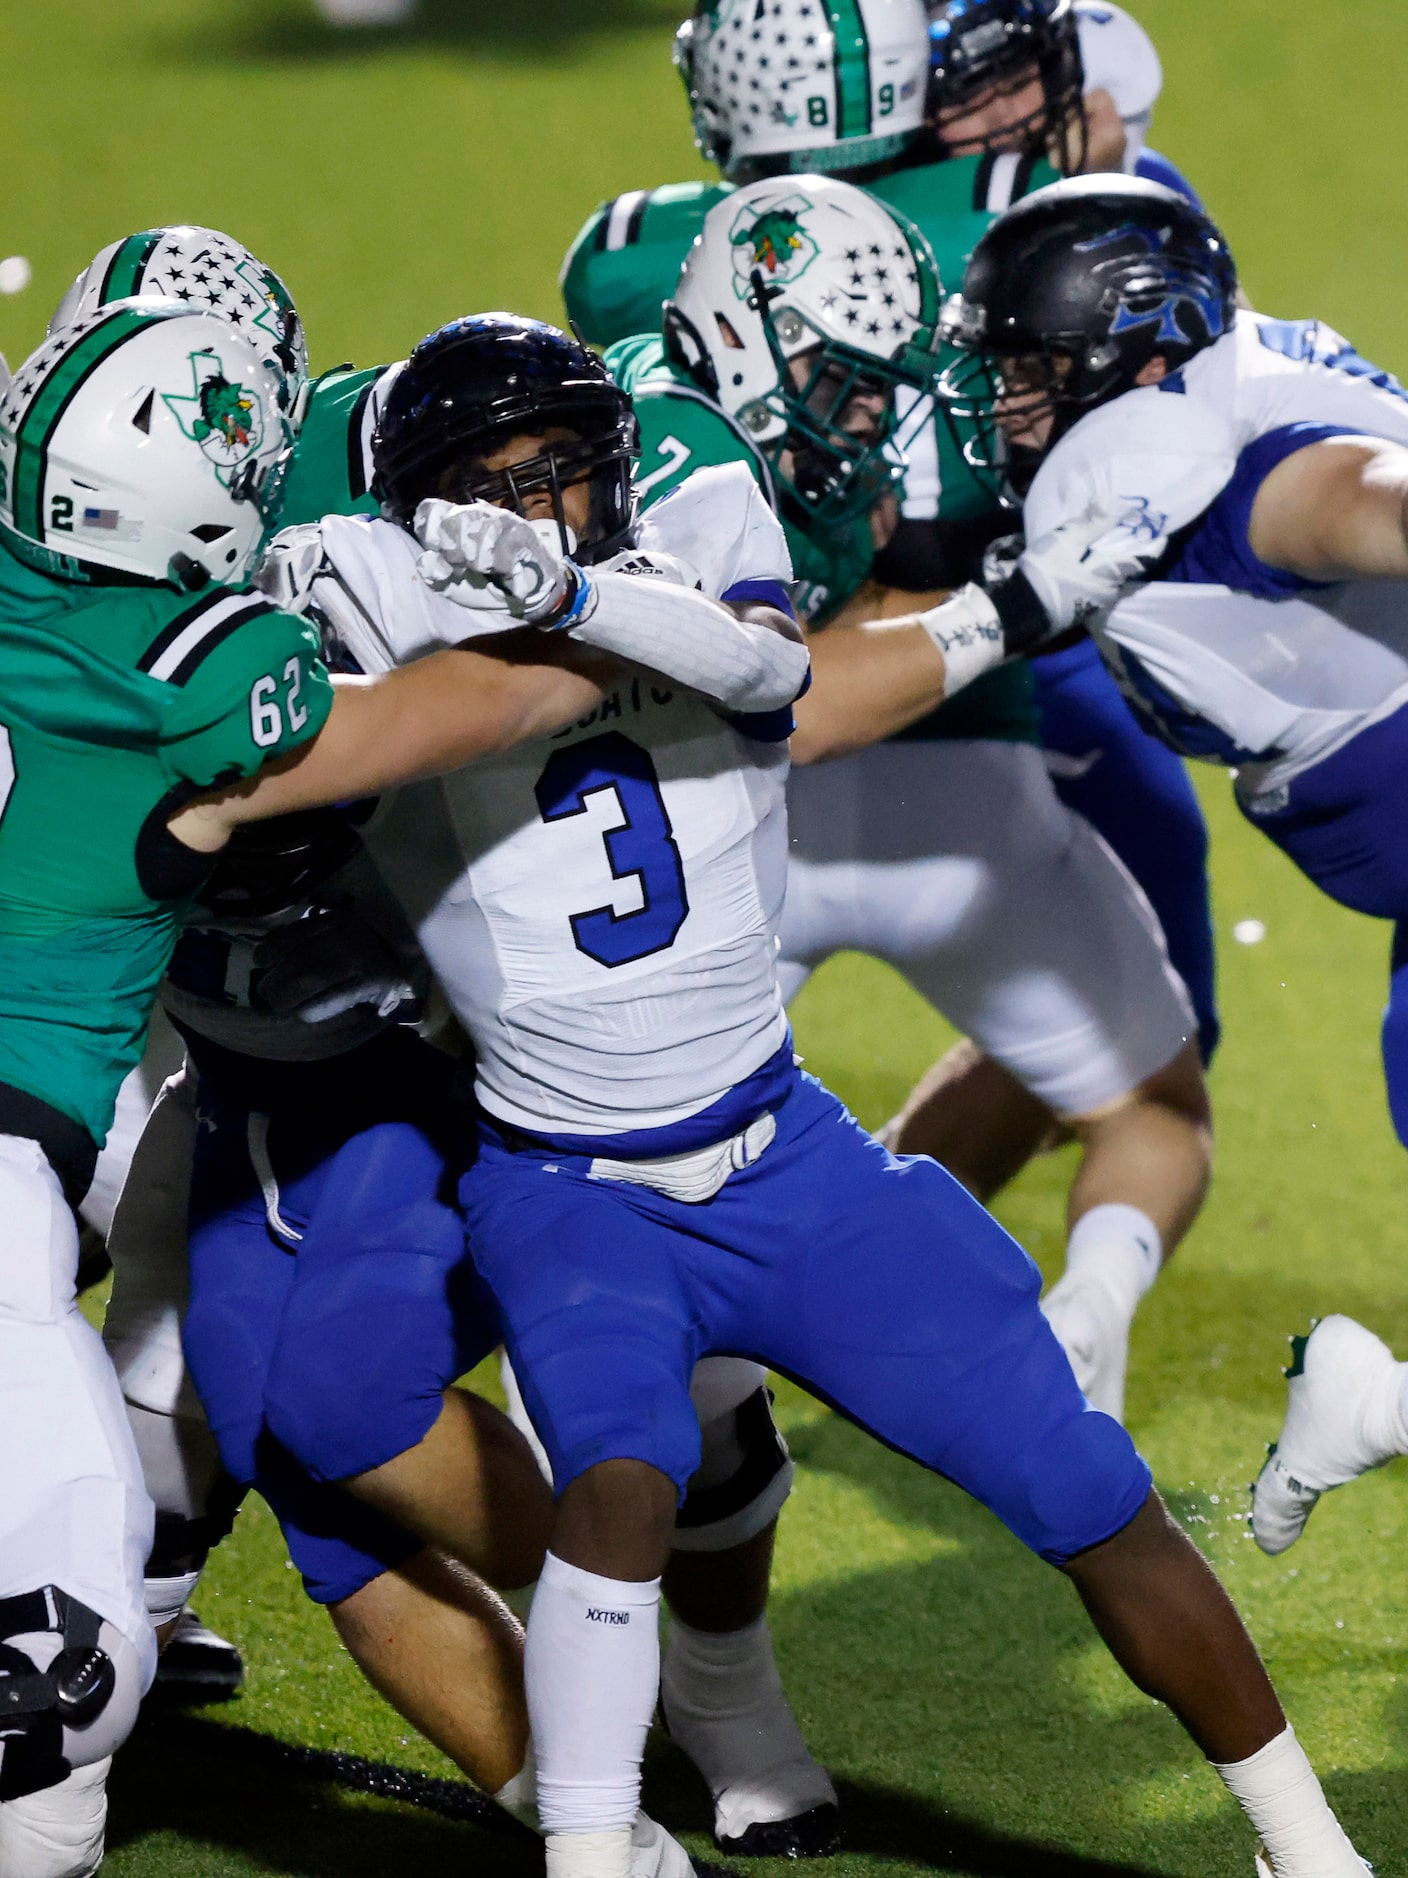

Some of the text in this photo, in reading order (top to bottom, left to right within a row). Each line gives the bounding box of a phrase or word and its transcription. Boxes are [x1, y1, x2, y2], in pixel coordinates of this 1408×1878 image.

[807, 83, 895, 127] 8 9
[51, 495, 74, 532] 2
[250, 655, 308, 747] 62
[534, 730, 690, 968] 3
